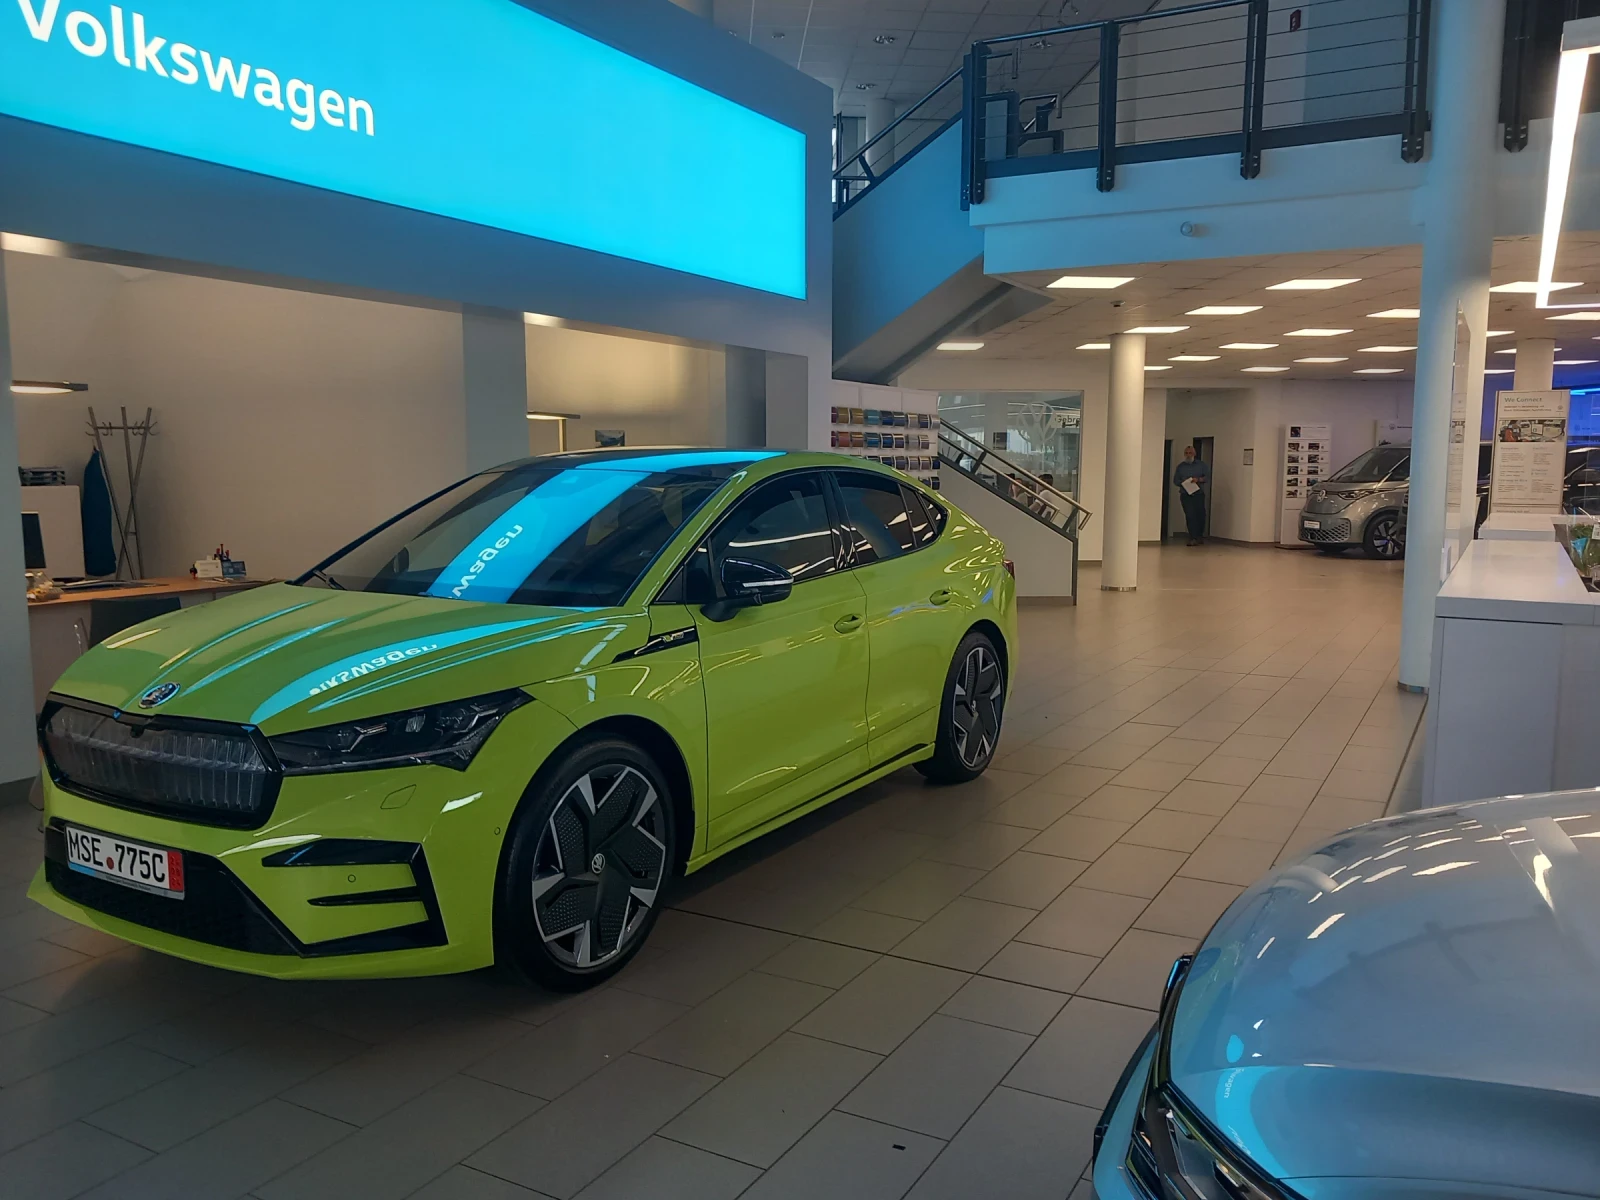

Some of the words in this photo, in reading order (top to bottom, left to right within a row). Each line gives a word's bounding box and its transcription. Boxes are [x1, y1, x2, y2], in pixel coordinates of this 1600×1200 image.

[16, 0, 376, 137] Volkswagen
[68, 830, 103, 867] MSE
[115, 843, 166, 882] 775C
